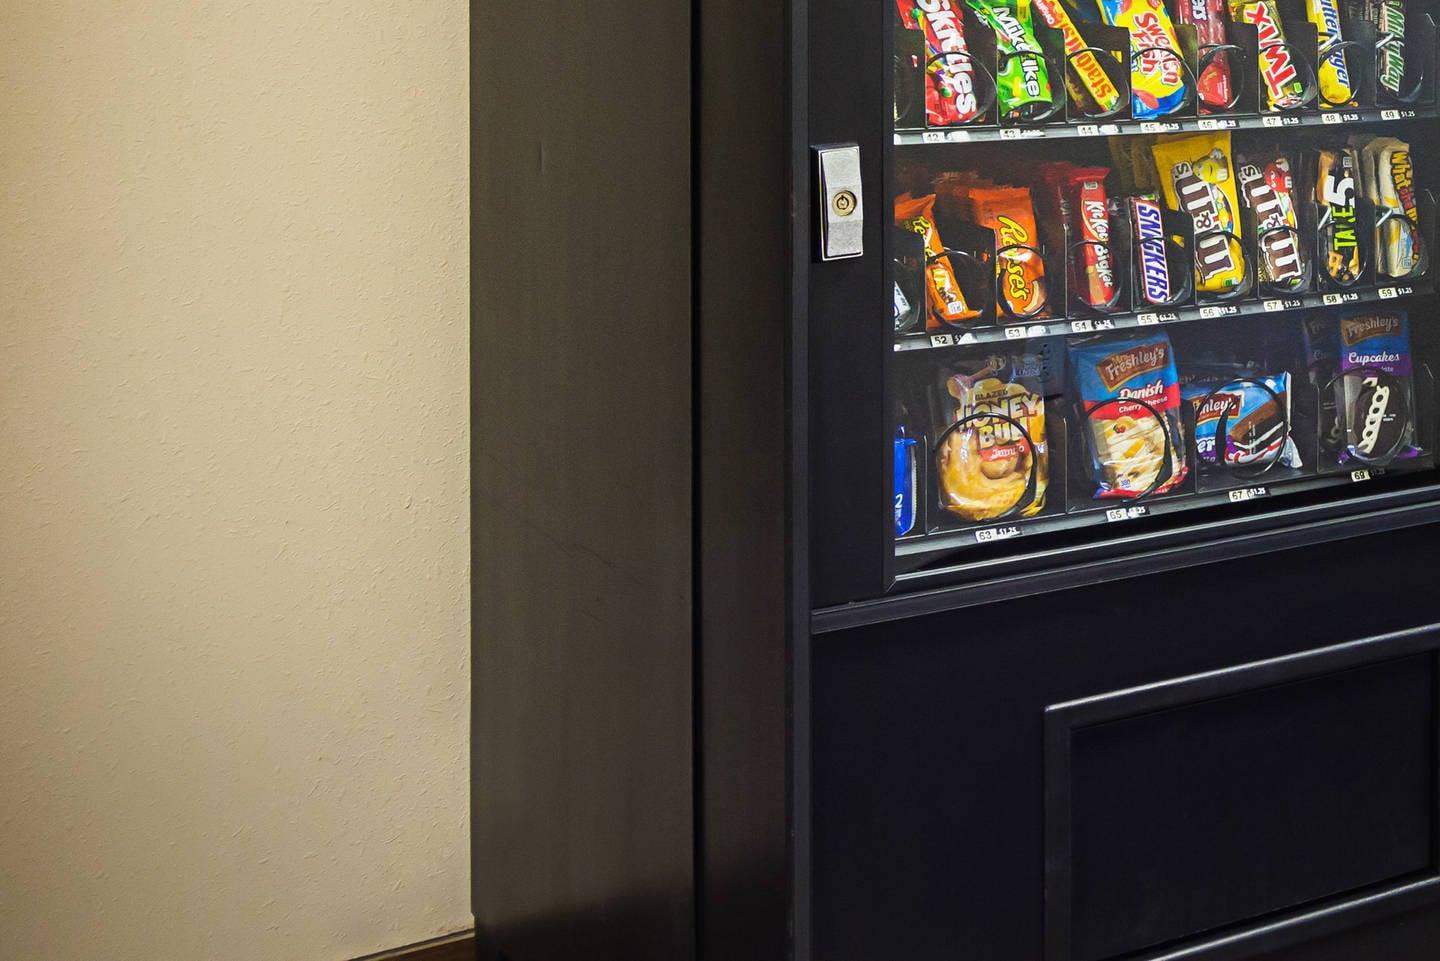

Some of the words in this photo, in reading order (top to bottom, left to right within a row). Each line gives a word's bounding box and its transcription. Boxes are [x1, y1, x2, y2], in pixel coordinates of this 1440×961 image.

[992, 6, 1027, 54] Mike
[1131, 30, 1157, 75] Fish
[1246, 1, 1297, 98] TWIX
[1380, 50, 1405, 92] Way
[1018, 56, 1042, 98] Ike
[1324, 114, 1337, 123] 48
[1343, 113, 1359, 121] $1.25
[1384, 111, 1396, 119] 49
[1401, 110, 1416, 118] $1.25
[1282, 117, 1299, 125] $1.25
[1324, 174, 1356, 207] 5
[1382, 289, 1393, 297] 59
[1398, 287, 1413, 295] $1.25
[1325, 295, 1338, 304] 58
[1342, 293, 1358, 301] $1.25
[1266, 301, 1278, 310] 57
[1285, 300, 1301, 308] $1.25
[1202, 308, 1215, 317] 56
[1140, 315, 1152, 324] 55
[1074, 322, 1086, 331] 54
[1347, 315, 1400, 337] Freshley's
[1008, 328, 1021, 338] 53
[933, 335, 948, 345] 52
[1104, 346, 1165, 381] Freshley's
[1348, 350, 1400, 366] Cupcakes
[1117, 379, 1164, 402] Danish
[955, 392, 1040, 430] HONEY
[1118, 403, 1142, 415] Cherry
[1354, 470, 1366, 480] 69
[1232, 491, 1242, 500] 67
[1109, 509, 1122, 520] 65
[978, 530, 992, 540] 63
